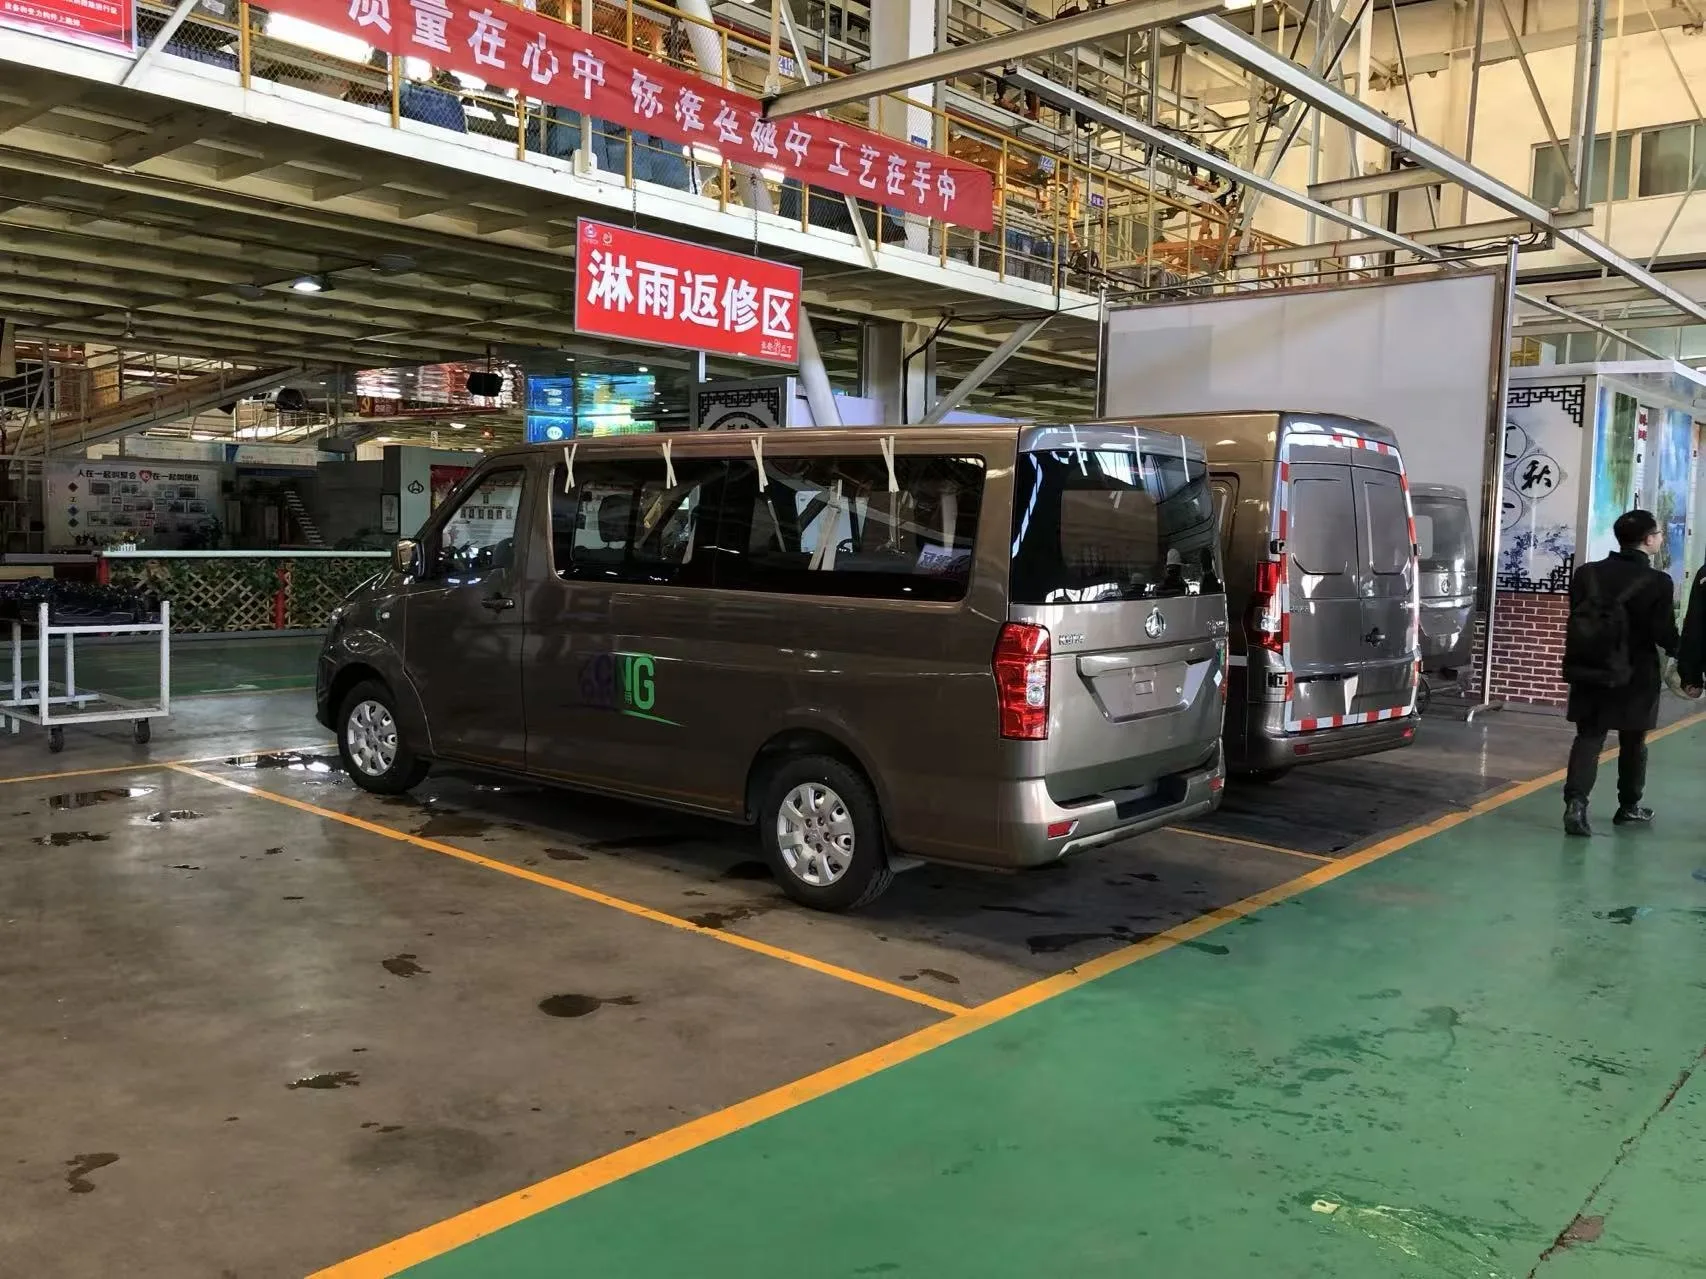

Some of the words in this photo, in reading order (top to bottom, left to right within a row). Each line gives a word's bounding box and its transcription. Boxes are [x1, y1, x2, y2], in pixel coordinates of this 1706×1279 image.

[827, 136, 956, 212] 工艺在手中
[587, 248, 795, 340] 淋雨返修区
[1521, 459, 1552, 491] 秋
